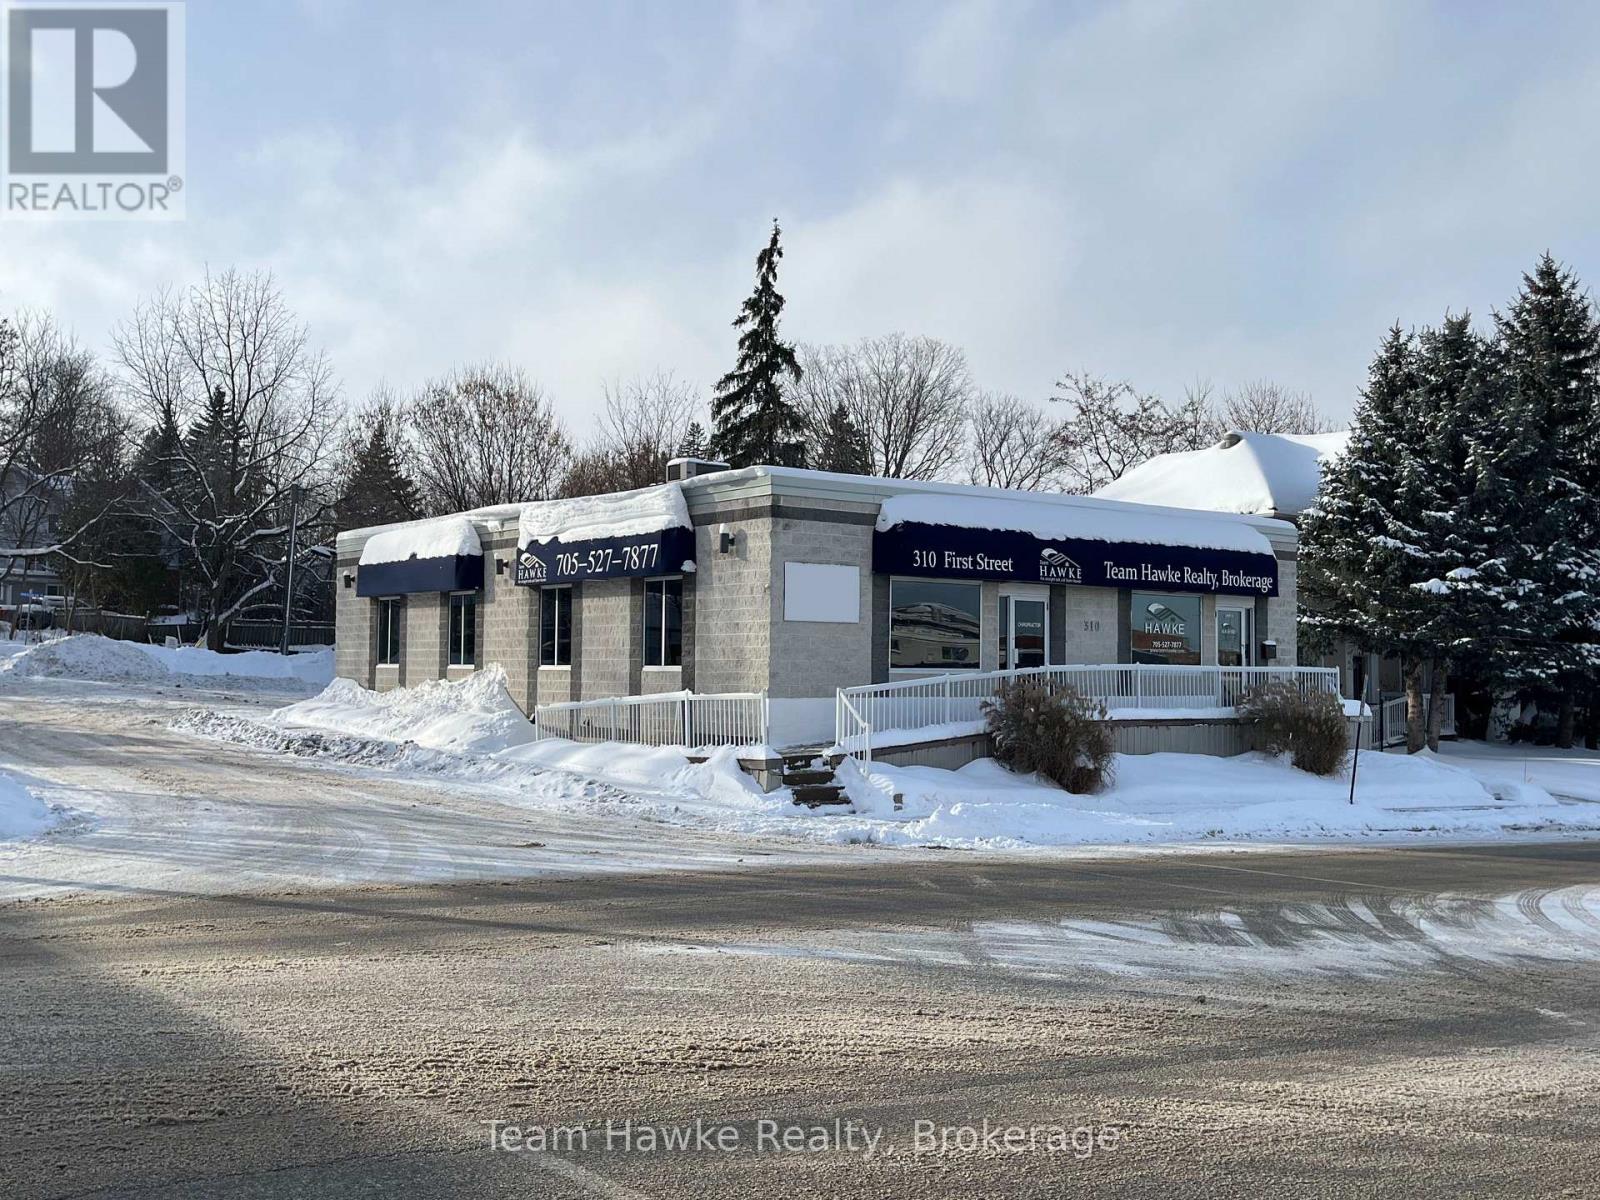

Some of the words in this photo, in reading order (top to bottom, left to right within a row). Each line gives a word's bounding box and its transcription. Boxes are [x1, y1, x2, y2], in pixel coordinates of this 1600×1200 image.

[555, 543, 659, 576] 705-527-7877
[913, 550, 937, 568] 310
[944, 551, 974, 570] First
[976, 553, 1014, 572] Street
[518, 567, 547, 580] HAWKE
[1039, 565, 1082, 579] HAWKE
[1104, 561, 1138, 580] Team
[1141, 563, 1181, 583] Hawke
[1183, 566, 1219, 590] Realty,
[1222, 570, 1273, 593] Brokerage
[1145, 622, 1185, 635] HAWKE
